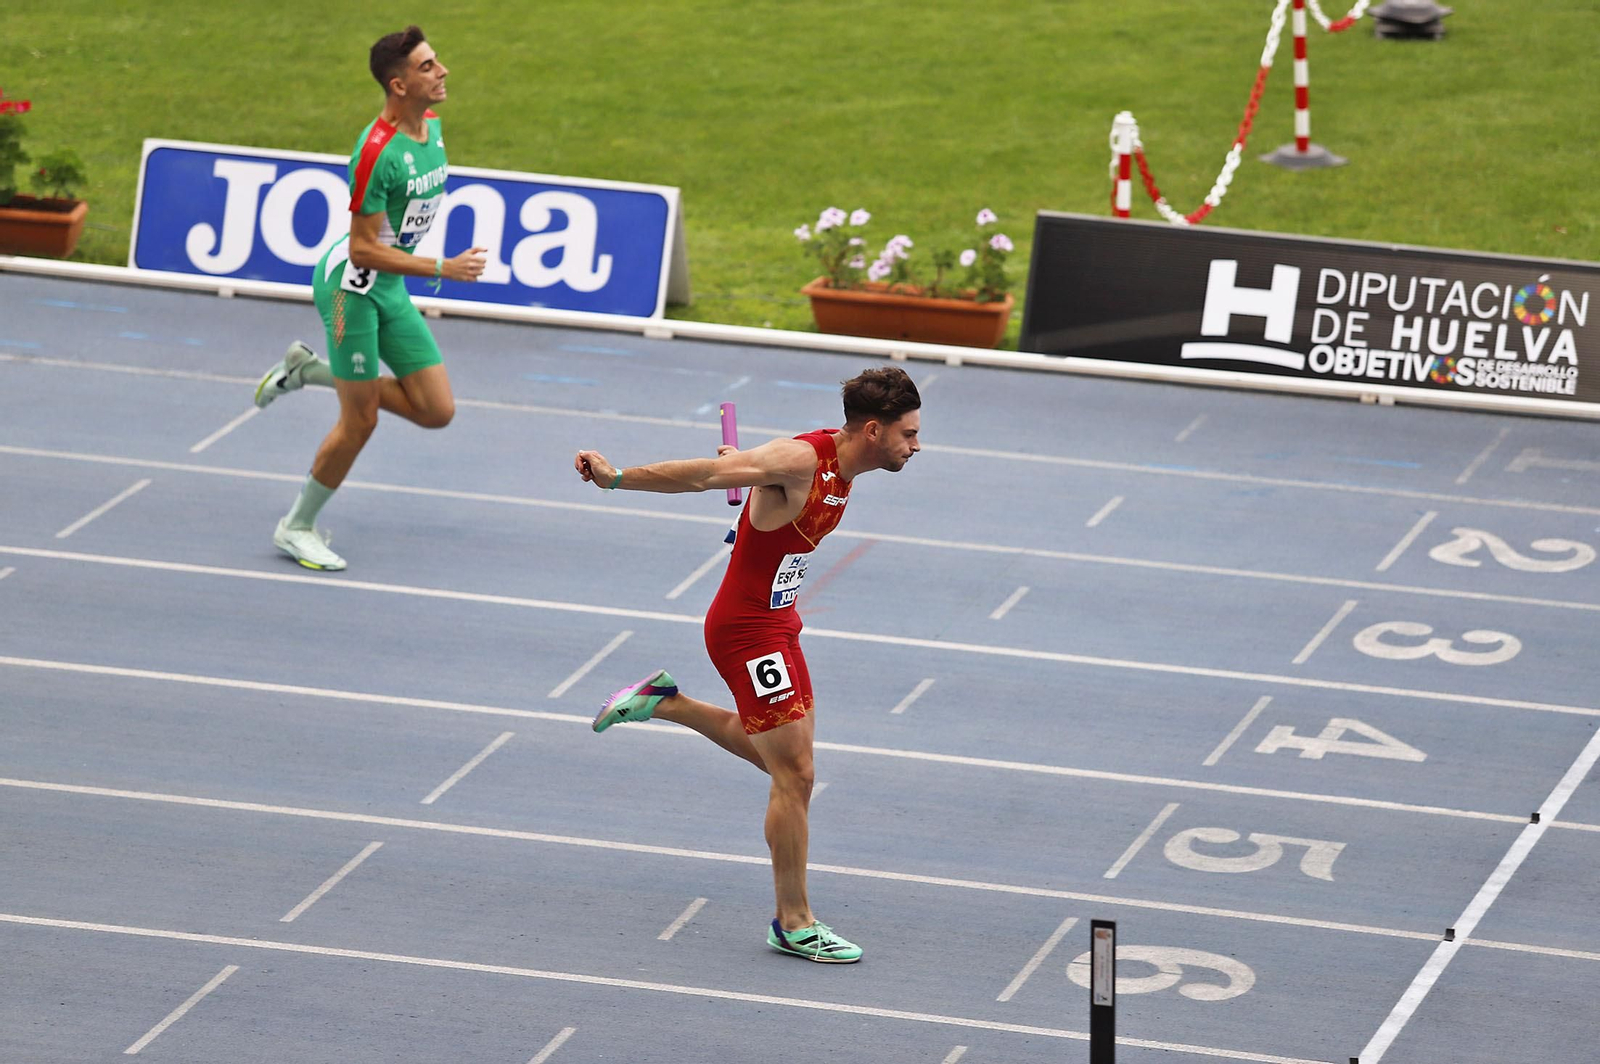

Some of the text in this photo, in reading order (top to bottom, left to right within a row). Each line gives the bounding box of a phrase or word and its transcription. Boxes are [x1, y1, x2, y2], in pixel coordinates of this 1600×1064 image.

[349, 266, 371, 289] 3
[1316, 268, 1590, 327] DIPUTACIÓN
[1201, 259, 1300, 344] H
[1311, 308, 1579, 366] DE HUELVA
[1308, 344, 1579, 387] OBJETIVOS DE DESARROLLO
[1474, 371, 1577, 396] SOSTENIBLE
[1429, 527, 1597, 573] 2
[777, 570, 796, 584] ESP
[1353, 620, 1523, 666] 3
[756, 659, 782, 689] 6
[769, 690, 796, 705] ESP
[1254, 717, 1428, 763] 4
[1163, 827, 1349, 882] 5
[1066, 944, 1257, 1002] 6
